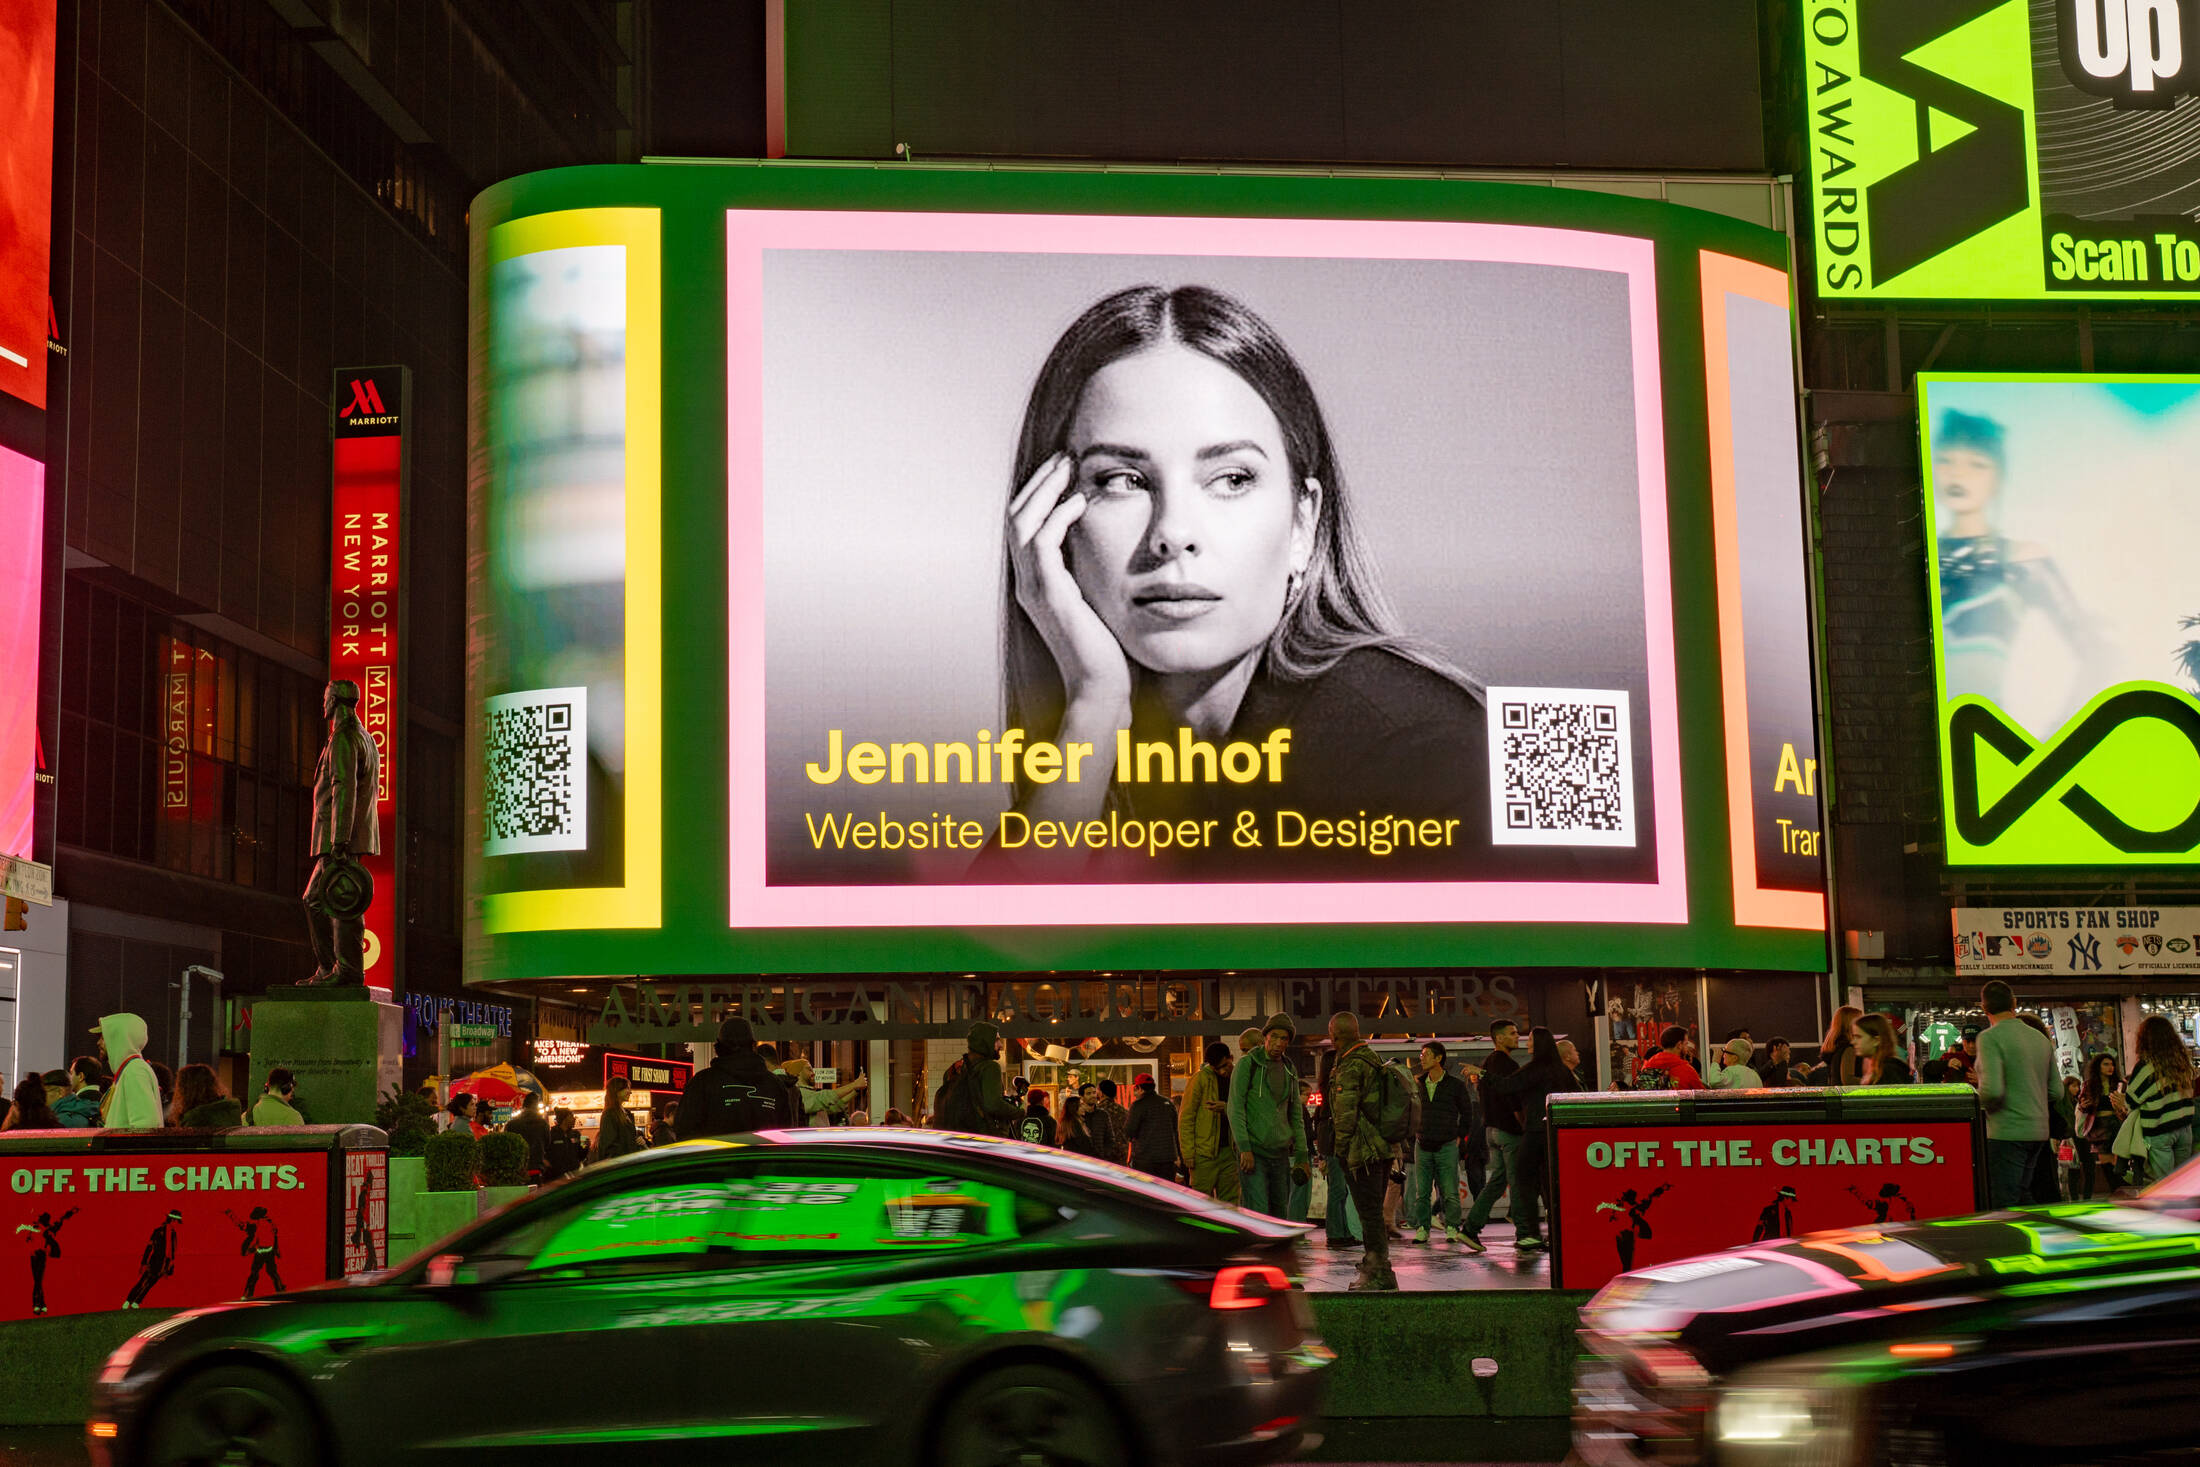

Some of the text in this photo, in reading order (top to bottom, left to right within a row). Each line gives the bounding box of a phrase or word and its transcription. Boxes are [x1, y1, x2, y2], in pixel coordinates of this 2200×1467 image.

[1815, 60, 1863, 290] AWARDS
[2051, 233, 2148, 281] Scan
[47, 340, 68, 357] RIOTT
[349, 416, 398, 426] MARRIOTT
[342, 514, 361, 656] NEW YORK
[369, 513, 389, 796] MARRIOTT MARQ
[805, 727, 1291, 785] Jennifer Inhof
[35, 773, 54, 784] RIOTT
[805, 810, 1460, 856] Website Developer & Designer
[2003, 911, 2160, 928] SPORTS FAN SHOP
[601, 975, 1519, 1027] AMERICAN EAGLE OUTFITTERS
[457, 1000, 513, 1038] THEATRE
[462, 1025, 495, 1039] Broadway
[2060, 1017, 2074, 1031] 22
[631, 1066, 641, 1081] THE
[641, 1067, 653, 1083] FIRST
[653, 1068, 670, 1084] SHADOW
[1307, 1093, 1323, 1106] PE
[346, 1155, 364, 1176] BEAT
[1587, 1137, 1944, 1168] OFF. THE. CHARTS.
[11, 1164, 305, 1194] OFF. THE. CHARTS.
[369, 1200, 386, 1230] BAD
[345, 1257, 367, 1273] JEAN
